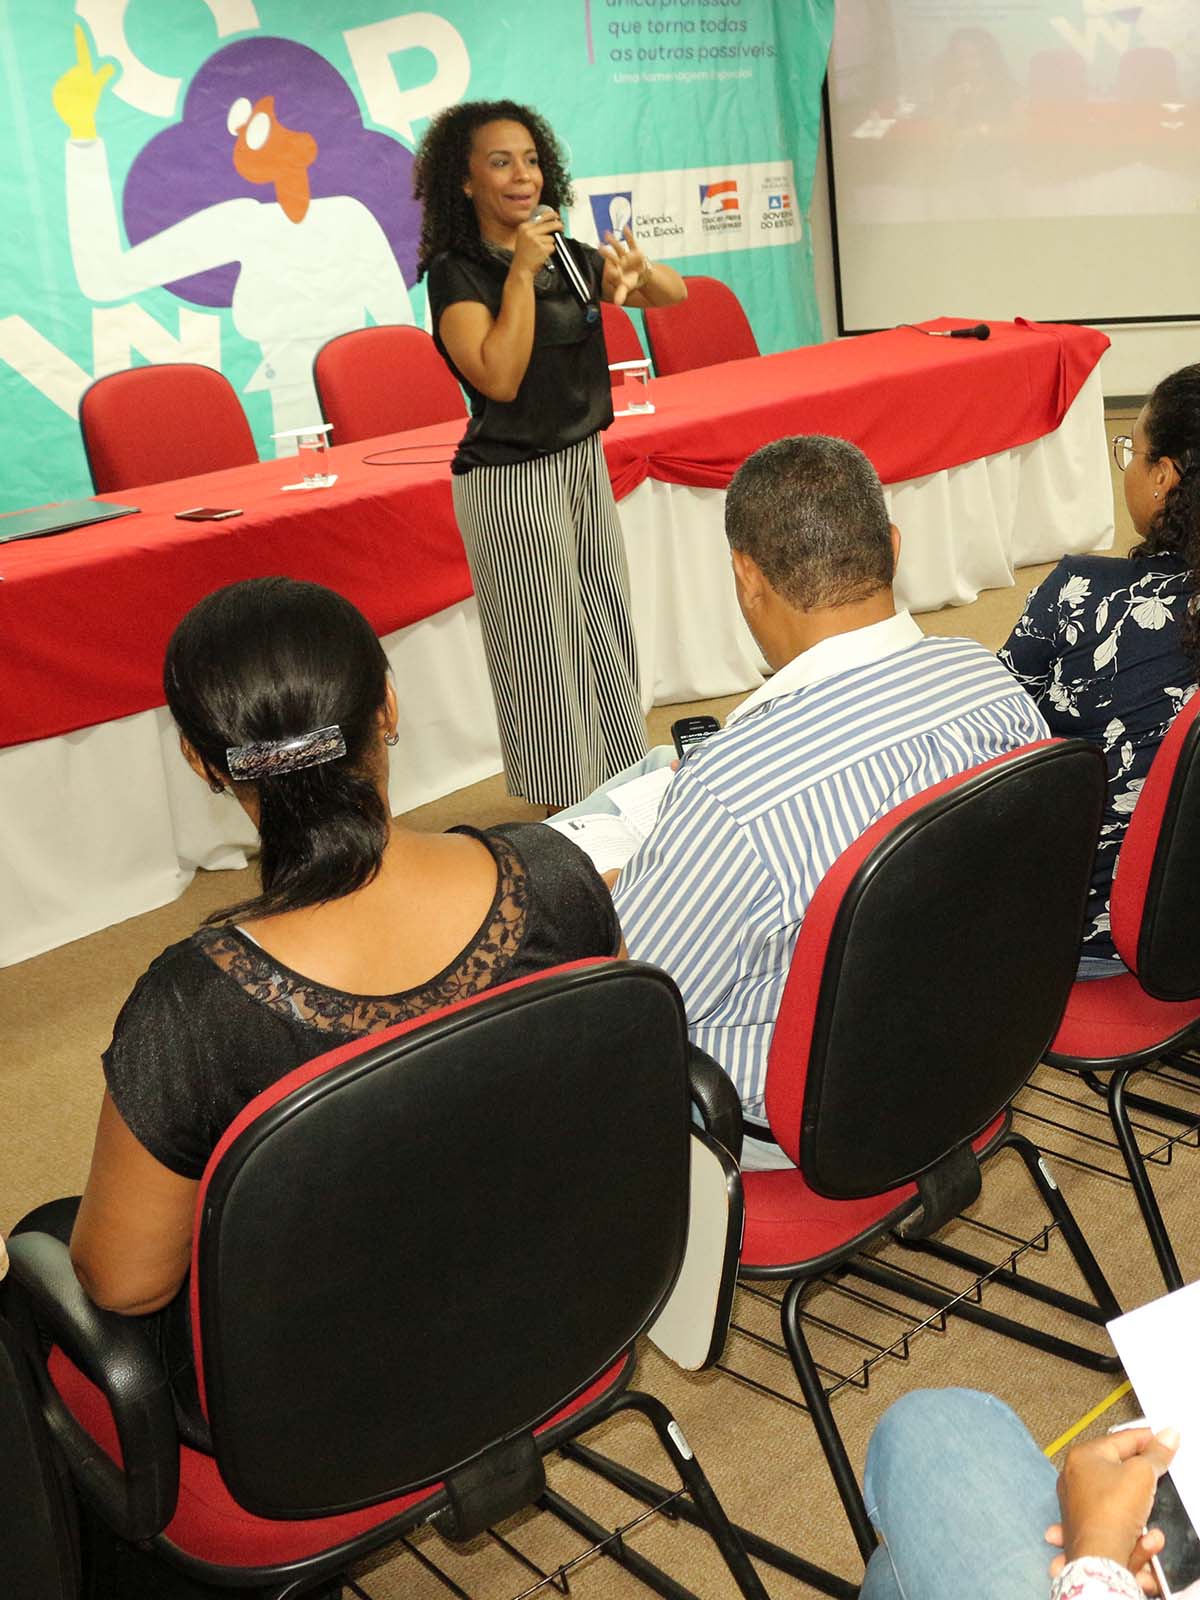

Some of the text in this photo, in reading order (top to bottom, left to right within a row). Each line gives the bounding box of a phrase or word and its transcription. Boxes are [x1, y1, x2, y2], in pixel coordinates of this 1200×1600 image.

[608, 17, 748, 39] que torna todas
[610, 47, 633, 62] as
[637, 44, 694, 62] outras
